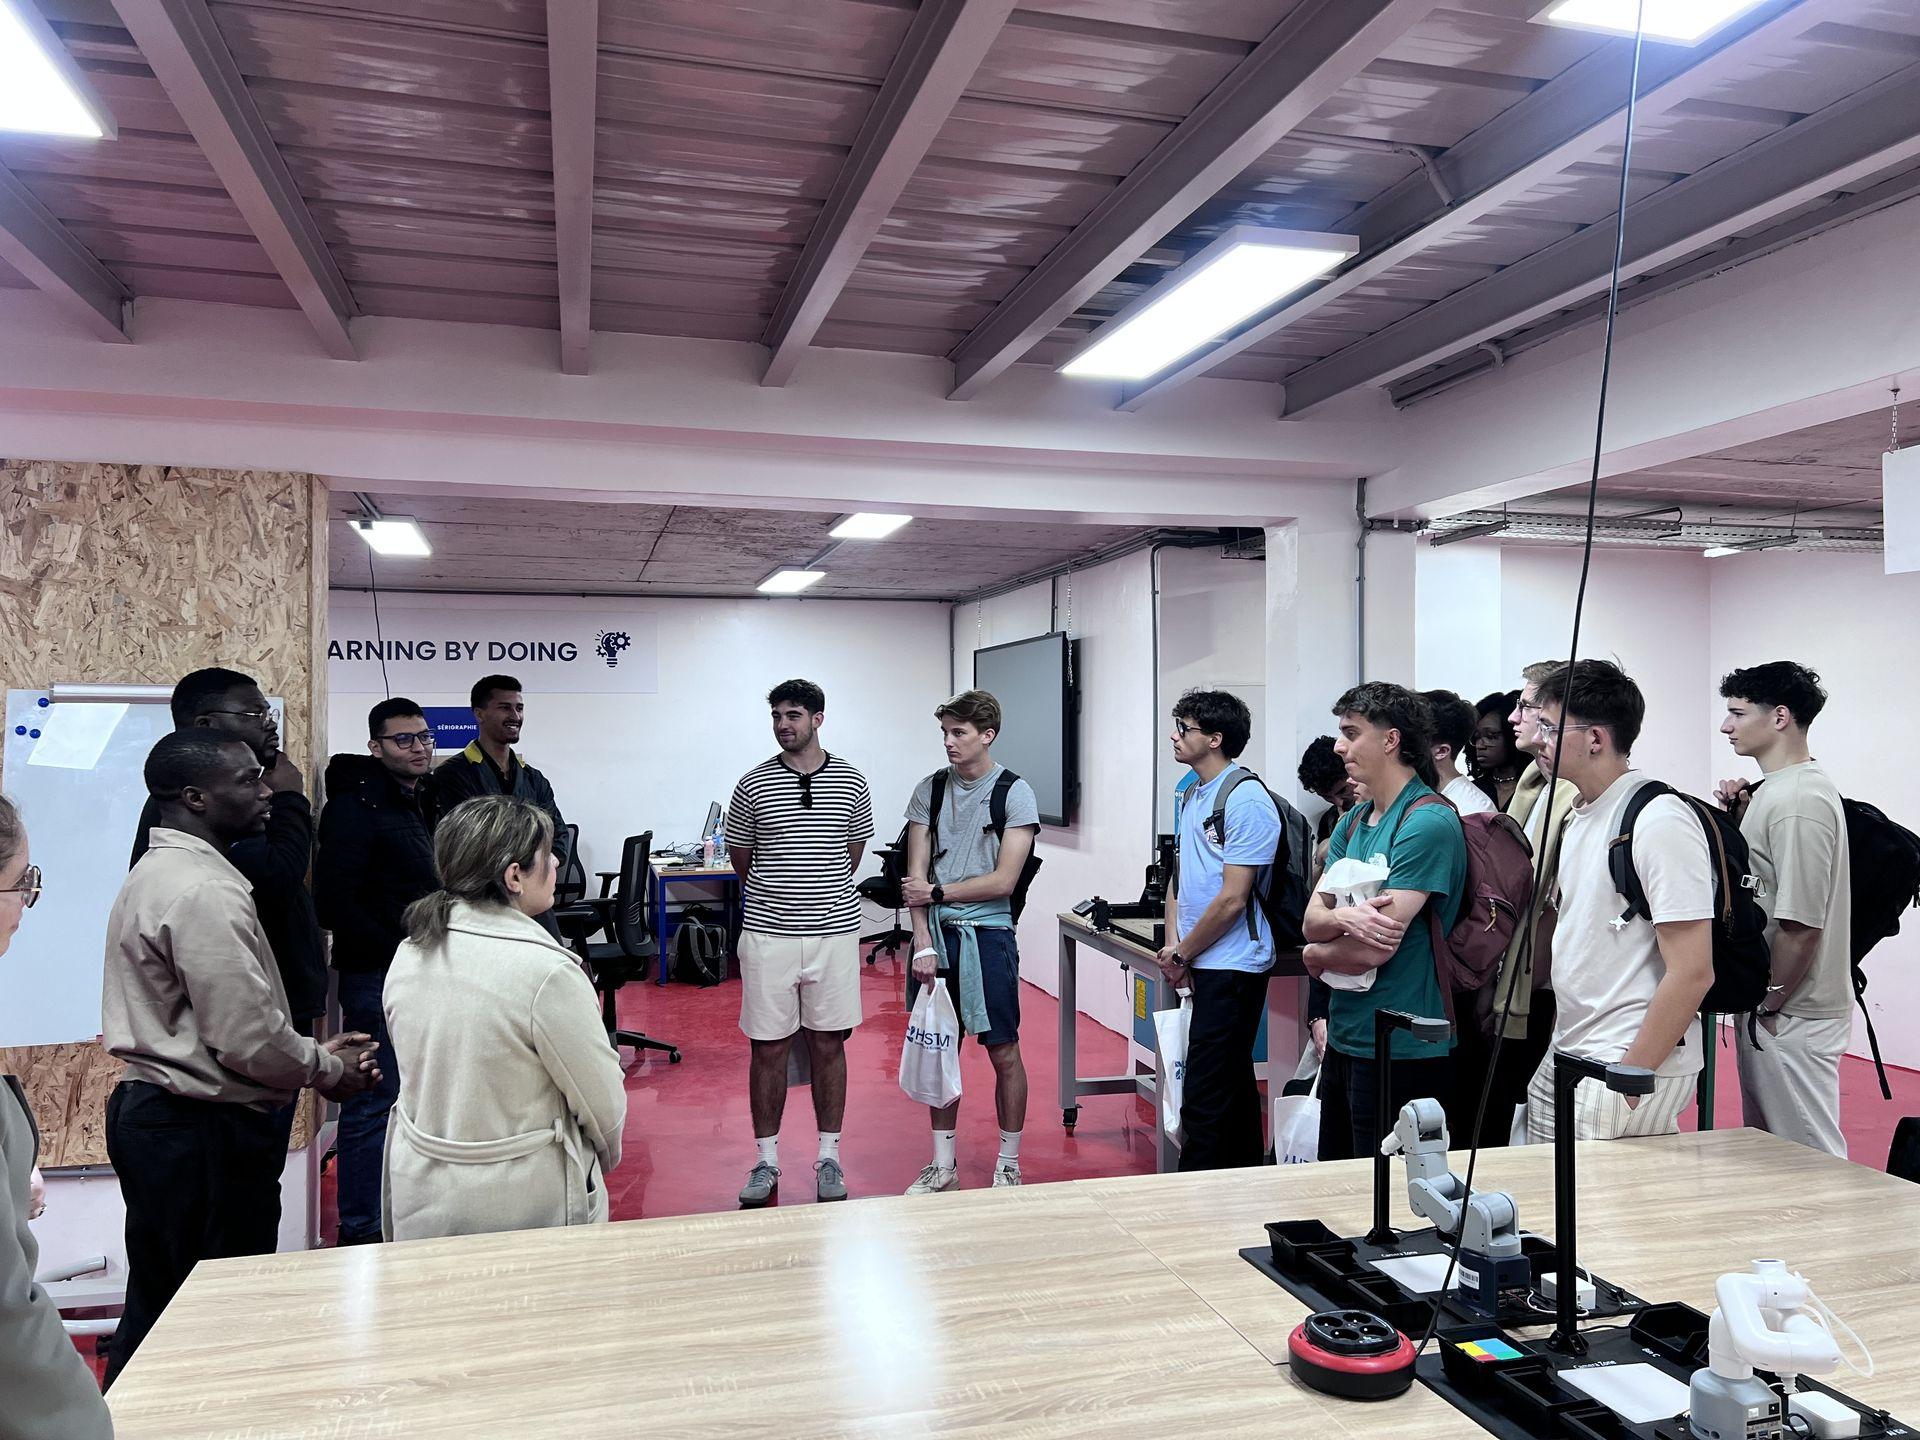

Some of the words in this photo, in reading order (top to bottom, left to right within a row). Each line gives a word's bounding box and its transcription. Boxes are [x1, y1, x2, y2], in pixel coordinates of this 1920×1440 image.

[327, 640, 437, 661] ARNING
[445, 641, 480, 661] BY
[488, 641, 578, 662] DOING
